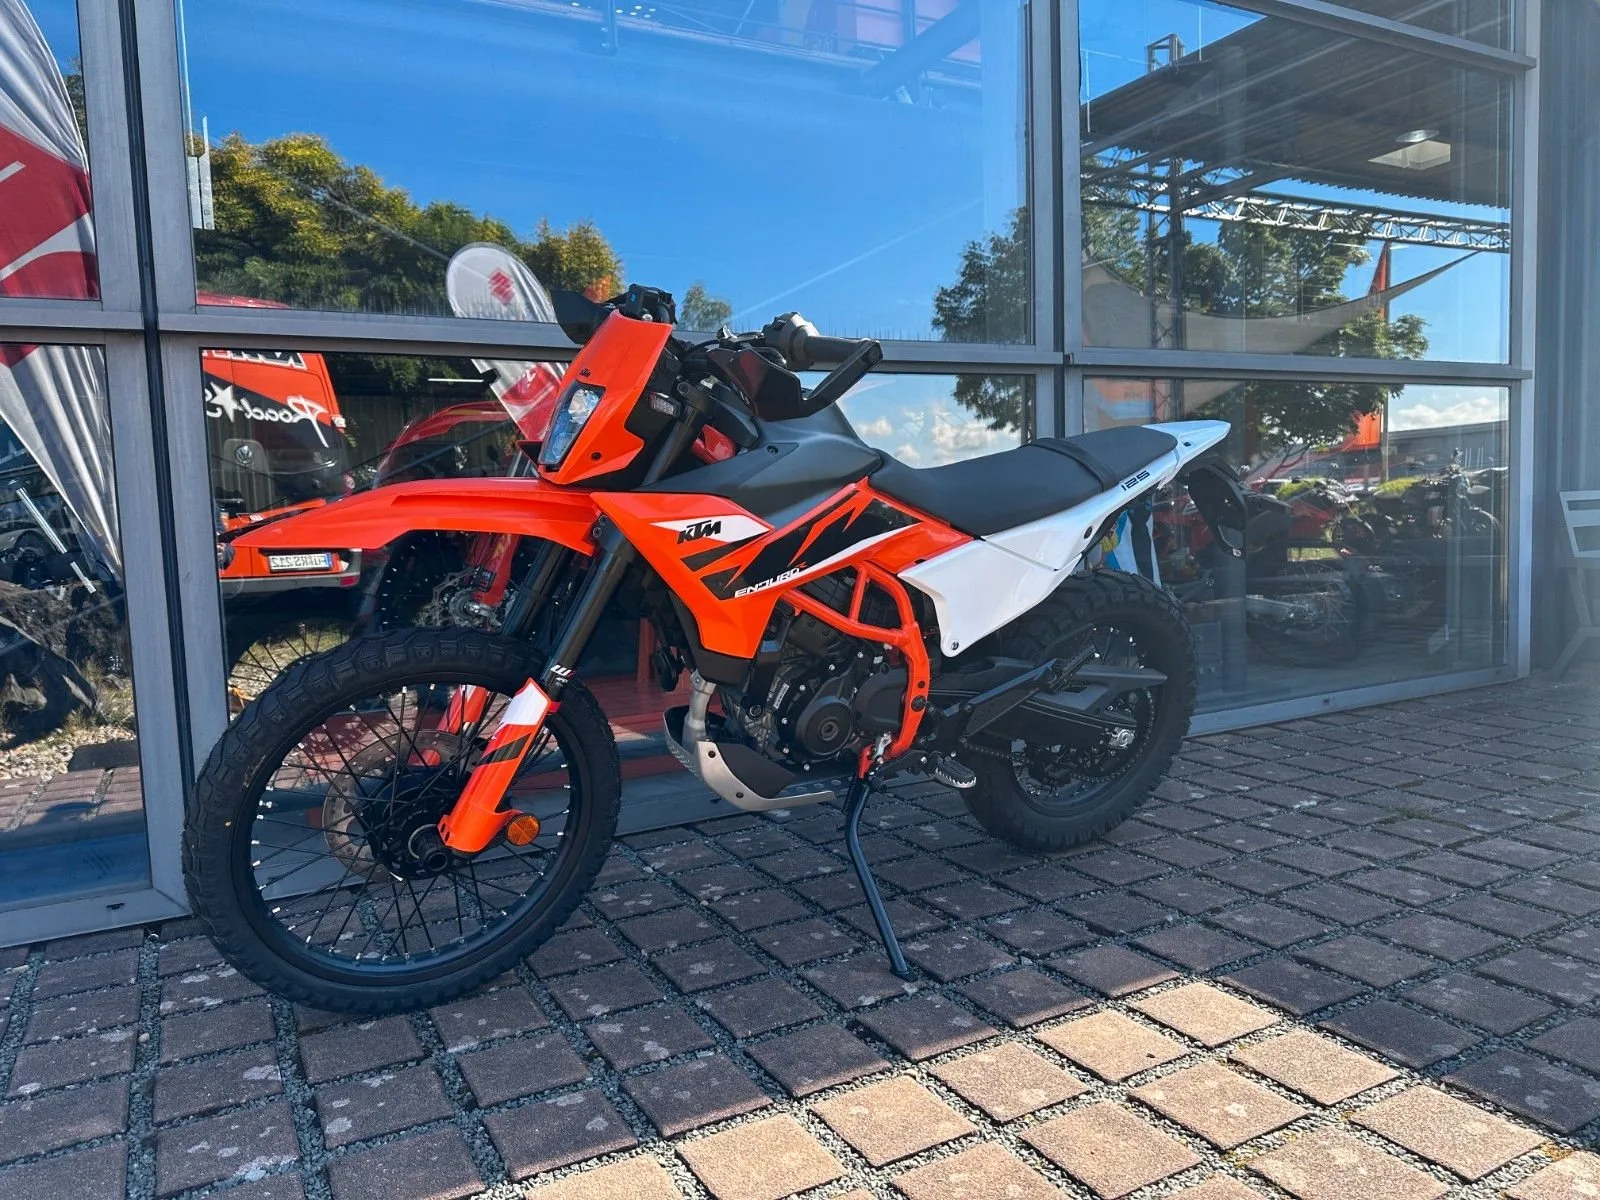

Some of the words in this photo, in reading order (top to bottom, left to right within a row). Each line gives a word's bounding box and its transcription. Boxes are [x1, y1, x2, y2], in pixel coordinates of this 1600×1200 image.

[1120, 470, 1151, 491] 125
[677, 519, 721, 544] KTM
[735, 567, 800, 598] ENDURO
